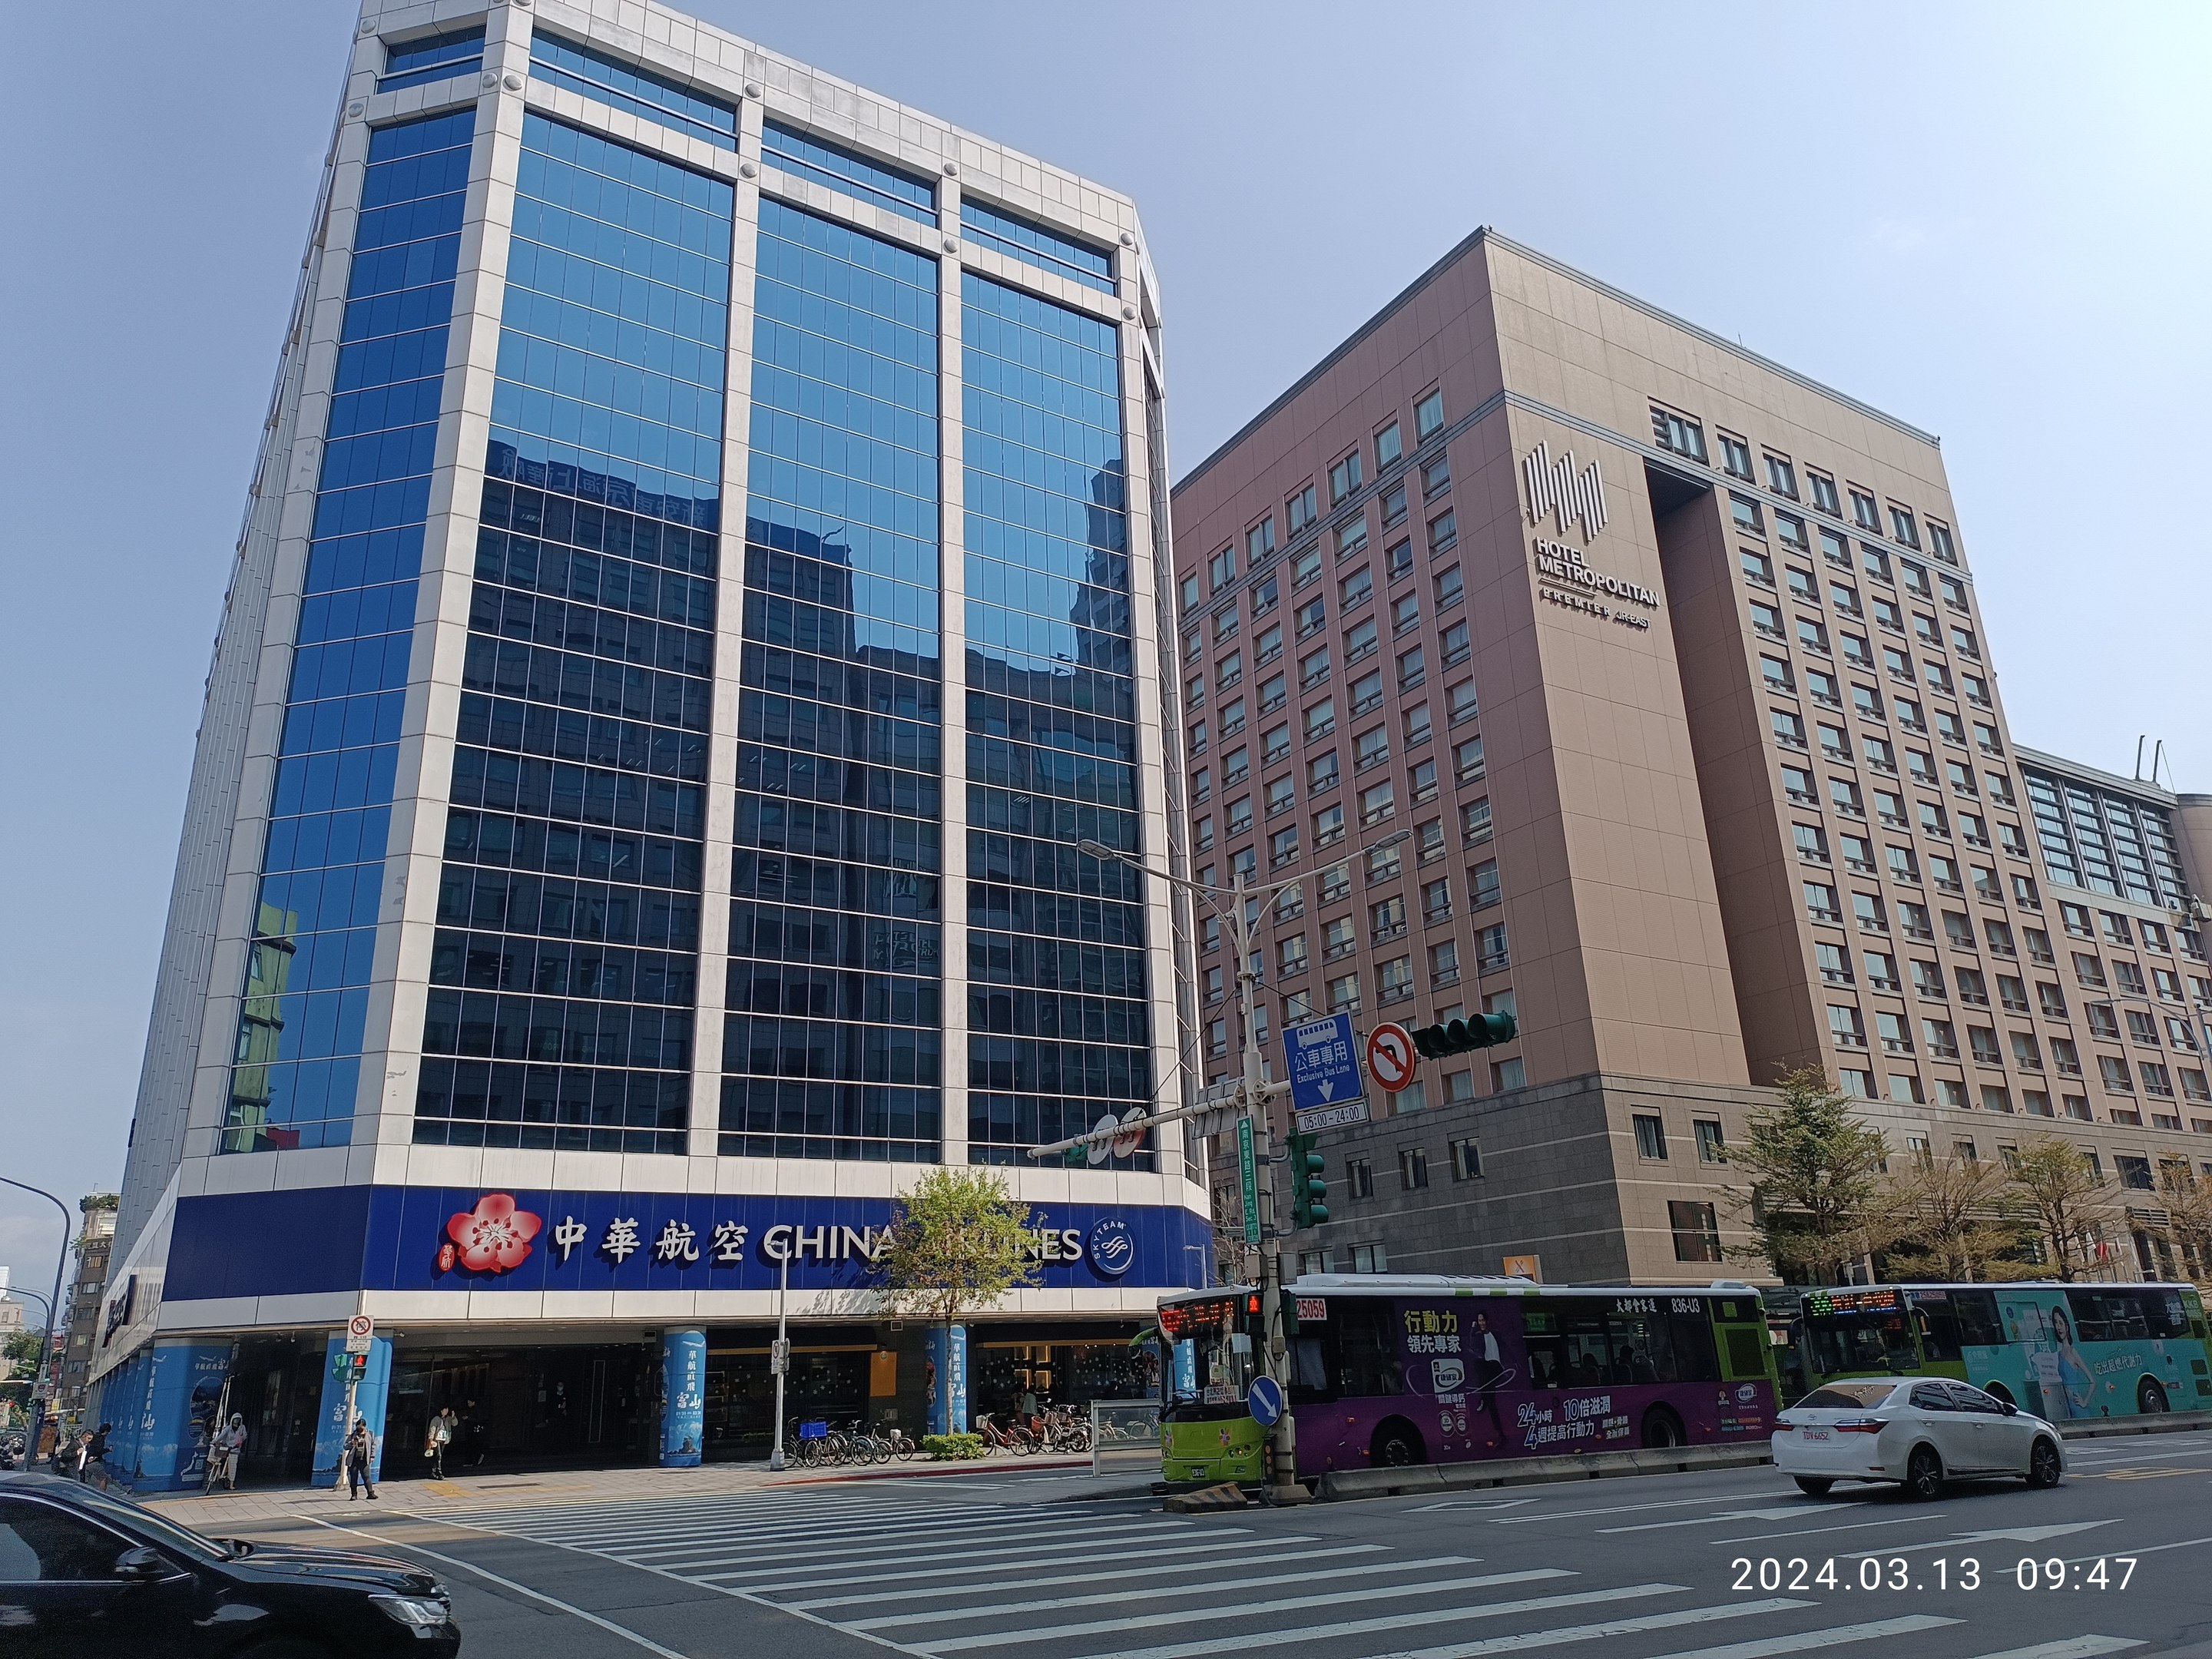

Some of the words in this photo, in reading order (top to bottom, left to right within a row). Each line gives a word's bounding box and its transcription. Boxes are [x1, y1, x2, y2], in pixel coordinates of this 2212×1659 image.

[1536, 536, 1590, 568] HOTEL
[1538, 554, 1660, 607] METROPOLITAN
[1543, 587, 1611, 617] PREMIER
[1616, 611, 1651, 628] JR-EAST
[1294, 1040, 1348, 1072] 公車專用
[1297, 1070, 1323, 1084] Exclusive
[1324, 1068, 1336, 1077] Bus
[1336, 1064, 1350, 1075] Lane
[1303, 1113, 1327, 1129] 05:00
[1336, 1107, 1359, 1123] 24:00
[1241, 1129, 1253, 1191] 南京東路三段
[555, 1215, 749, 1263] 中華航空
[763, 1224, 900, 1260] CHINA
[1093, 1220, 1124, 1260] SKYTEAM
[1296, 1300, 1325, 1318] 25059
[1616, 1297, 1657, 1313] 大都會客運
[1671, 1297, 1700, 1313] 836-U3
[1403, 1310, 1458, 1333] 行動力
[1407, 1334, 1462, 1353] 領先專家
[676, 1391, 701, 1409] 富山
[1517, 1402, 1553, 1428] 24小時
[1563, 1395, 1611, 1422] 10倍滋潤
[1524, 1419, 1594, 1450] 4週提高行動力
